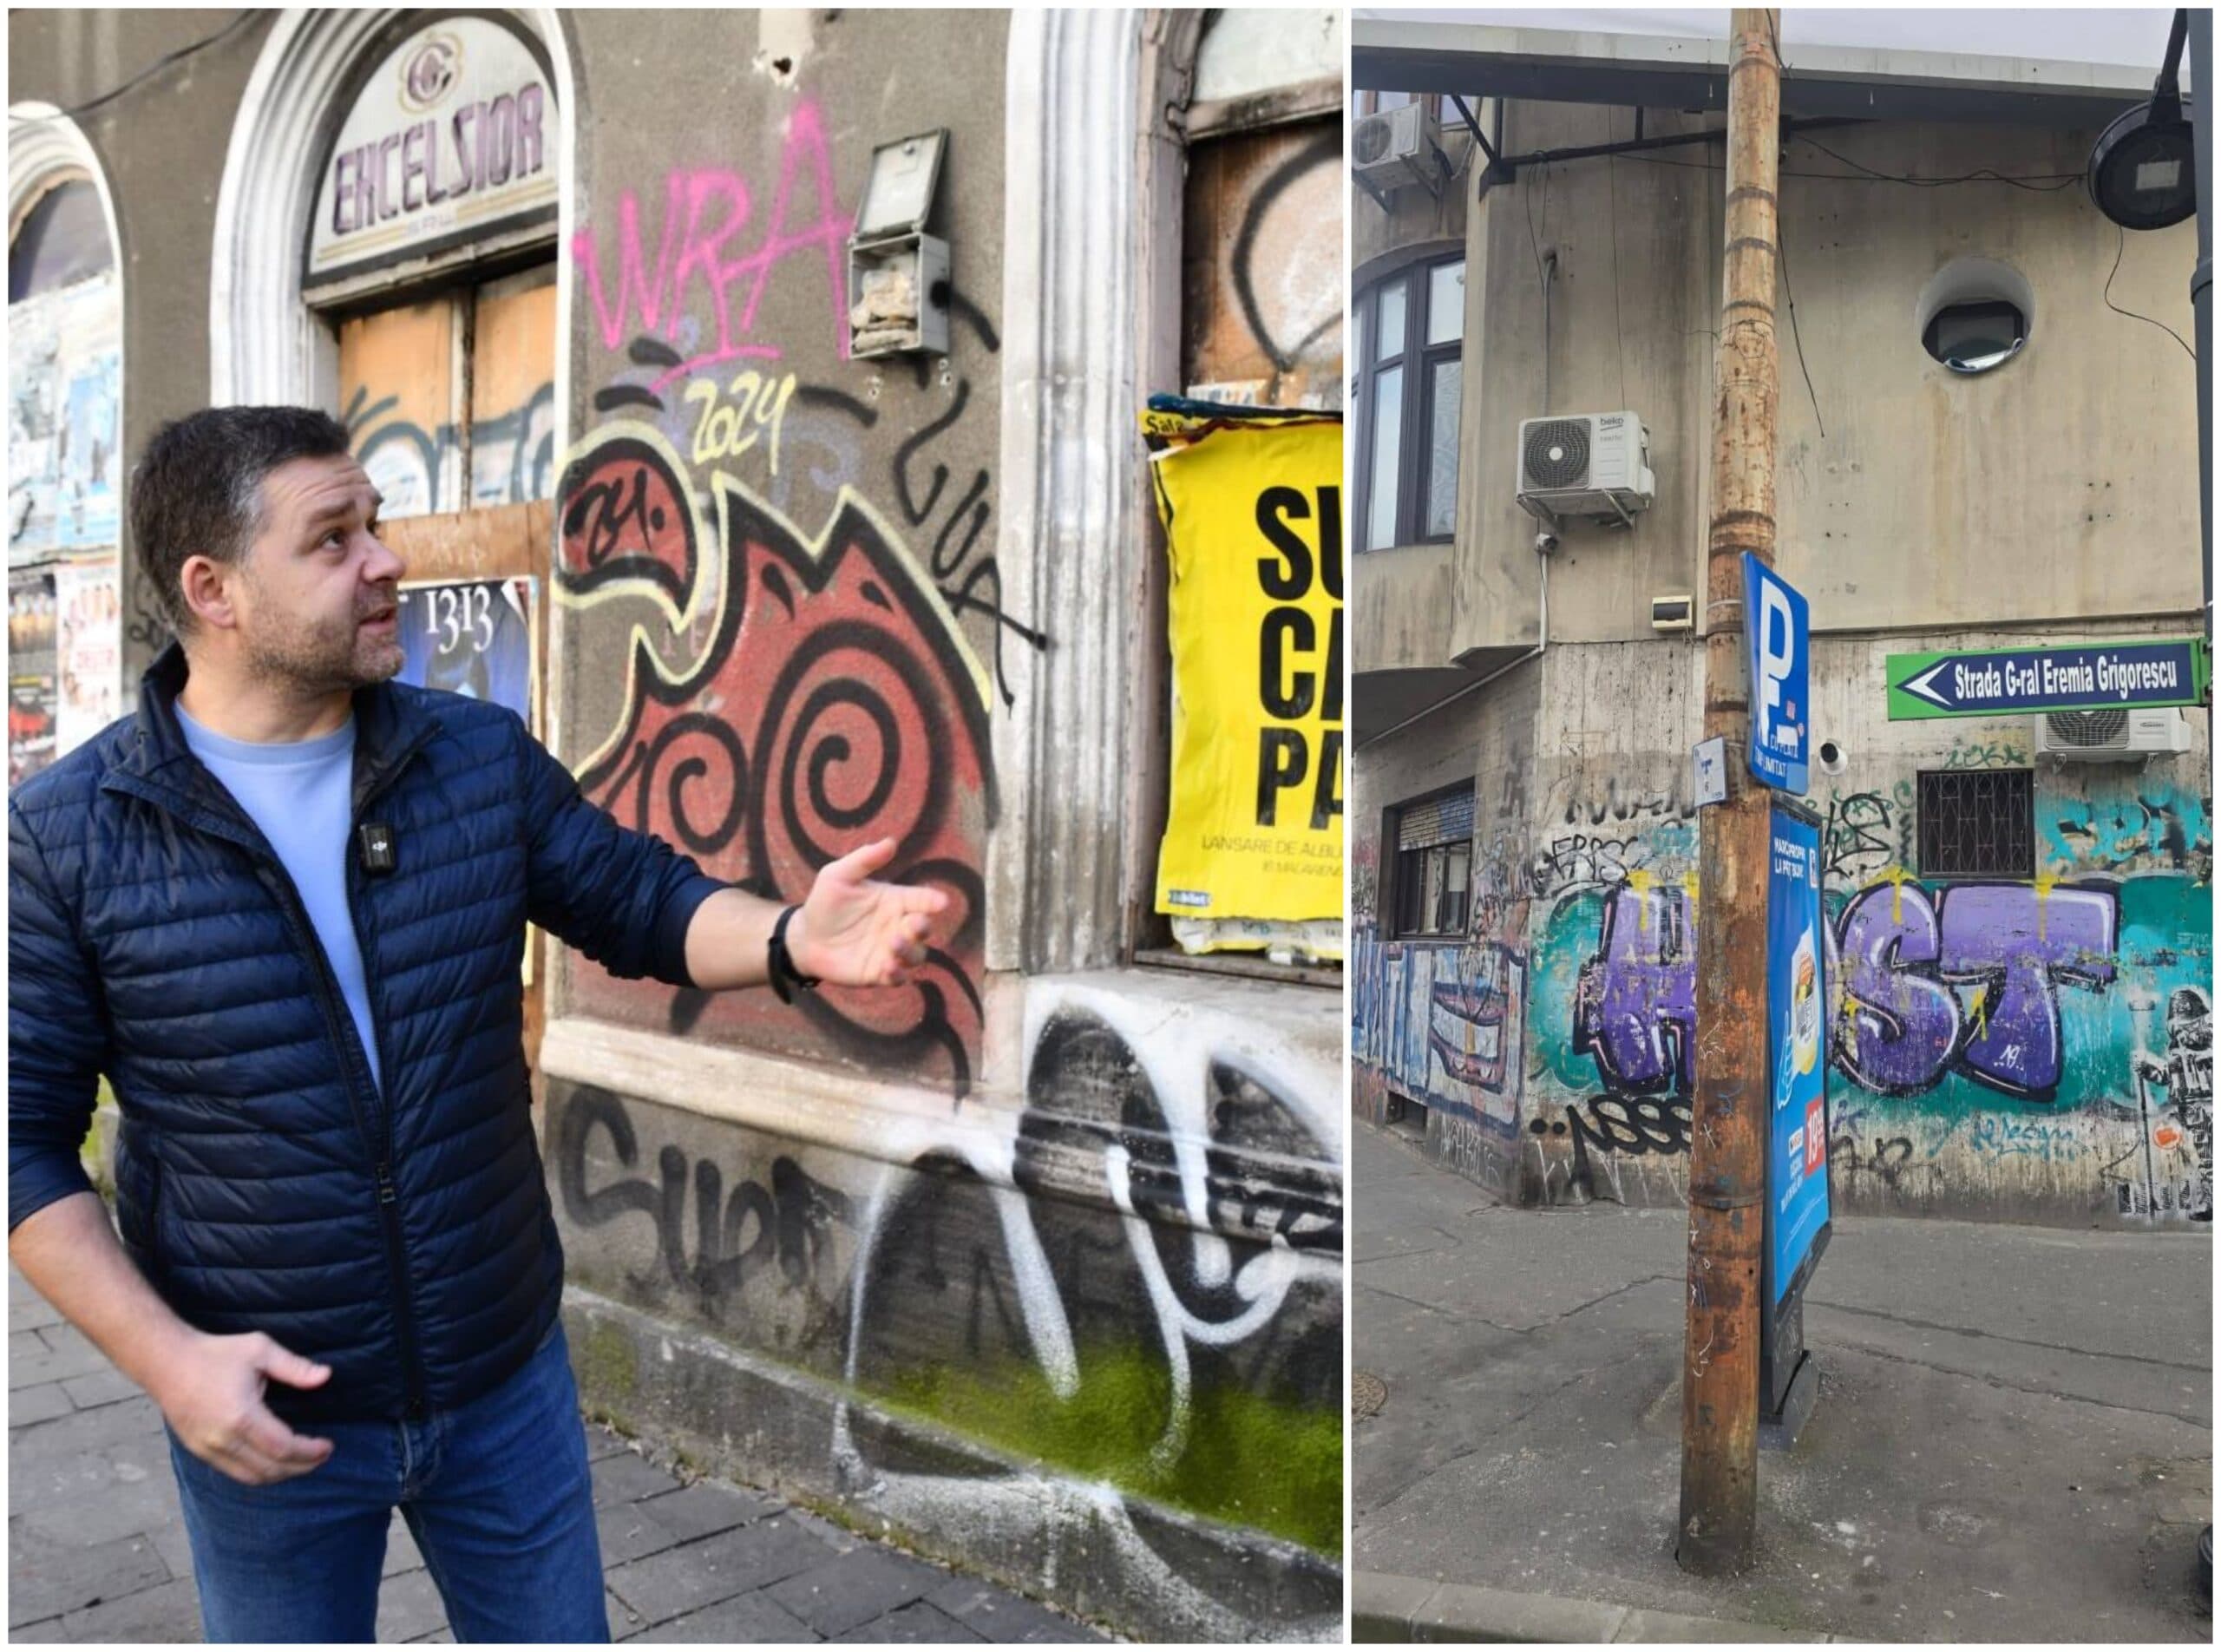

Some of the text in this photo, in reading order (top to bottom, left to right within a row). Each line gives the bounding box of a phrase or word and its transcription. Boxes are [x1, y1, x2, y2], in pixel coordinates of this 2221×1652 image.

[332, 82, 544, 236] EXCELSIOR
[425, 584, 494, 655] 1313
[1955, 654, 2177, 699] Strada G-ral Eremia Grigorescu
[1201, 836, 1273, 854] LANSARE
[1275, 839, 1299, 856] DE
